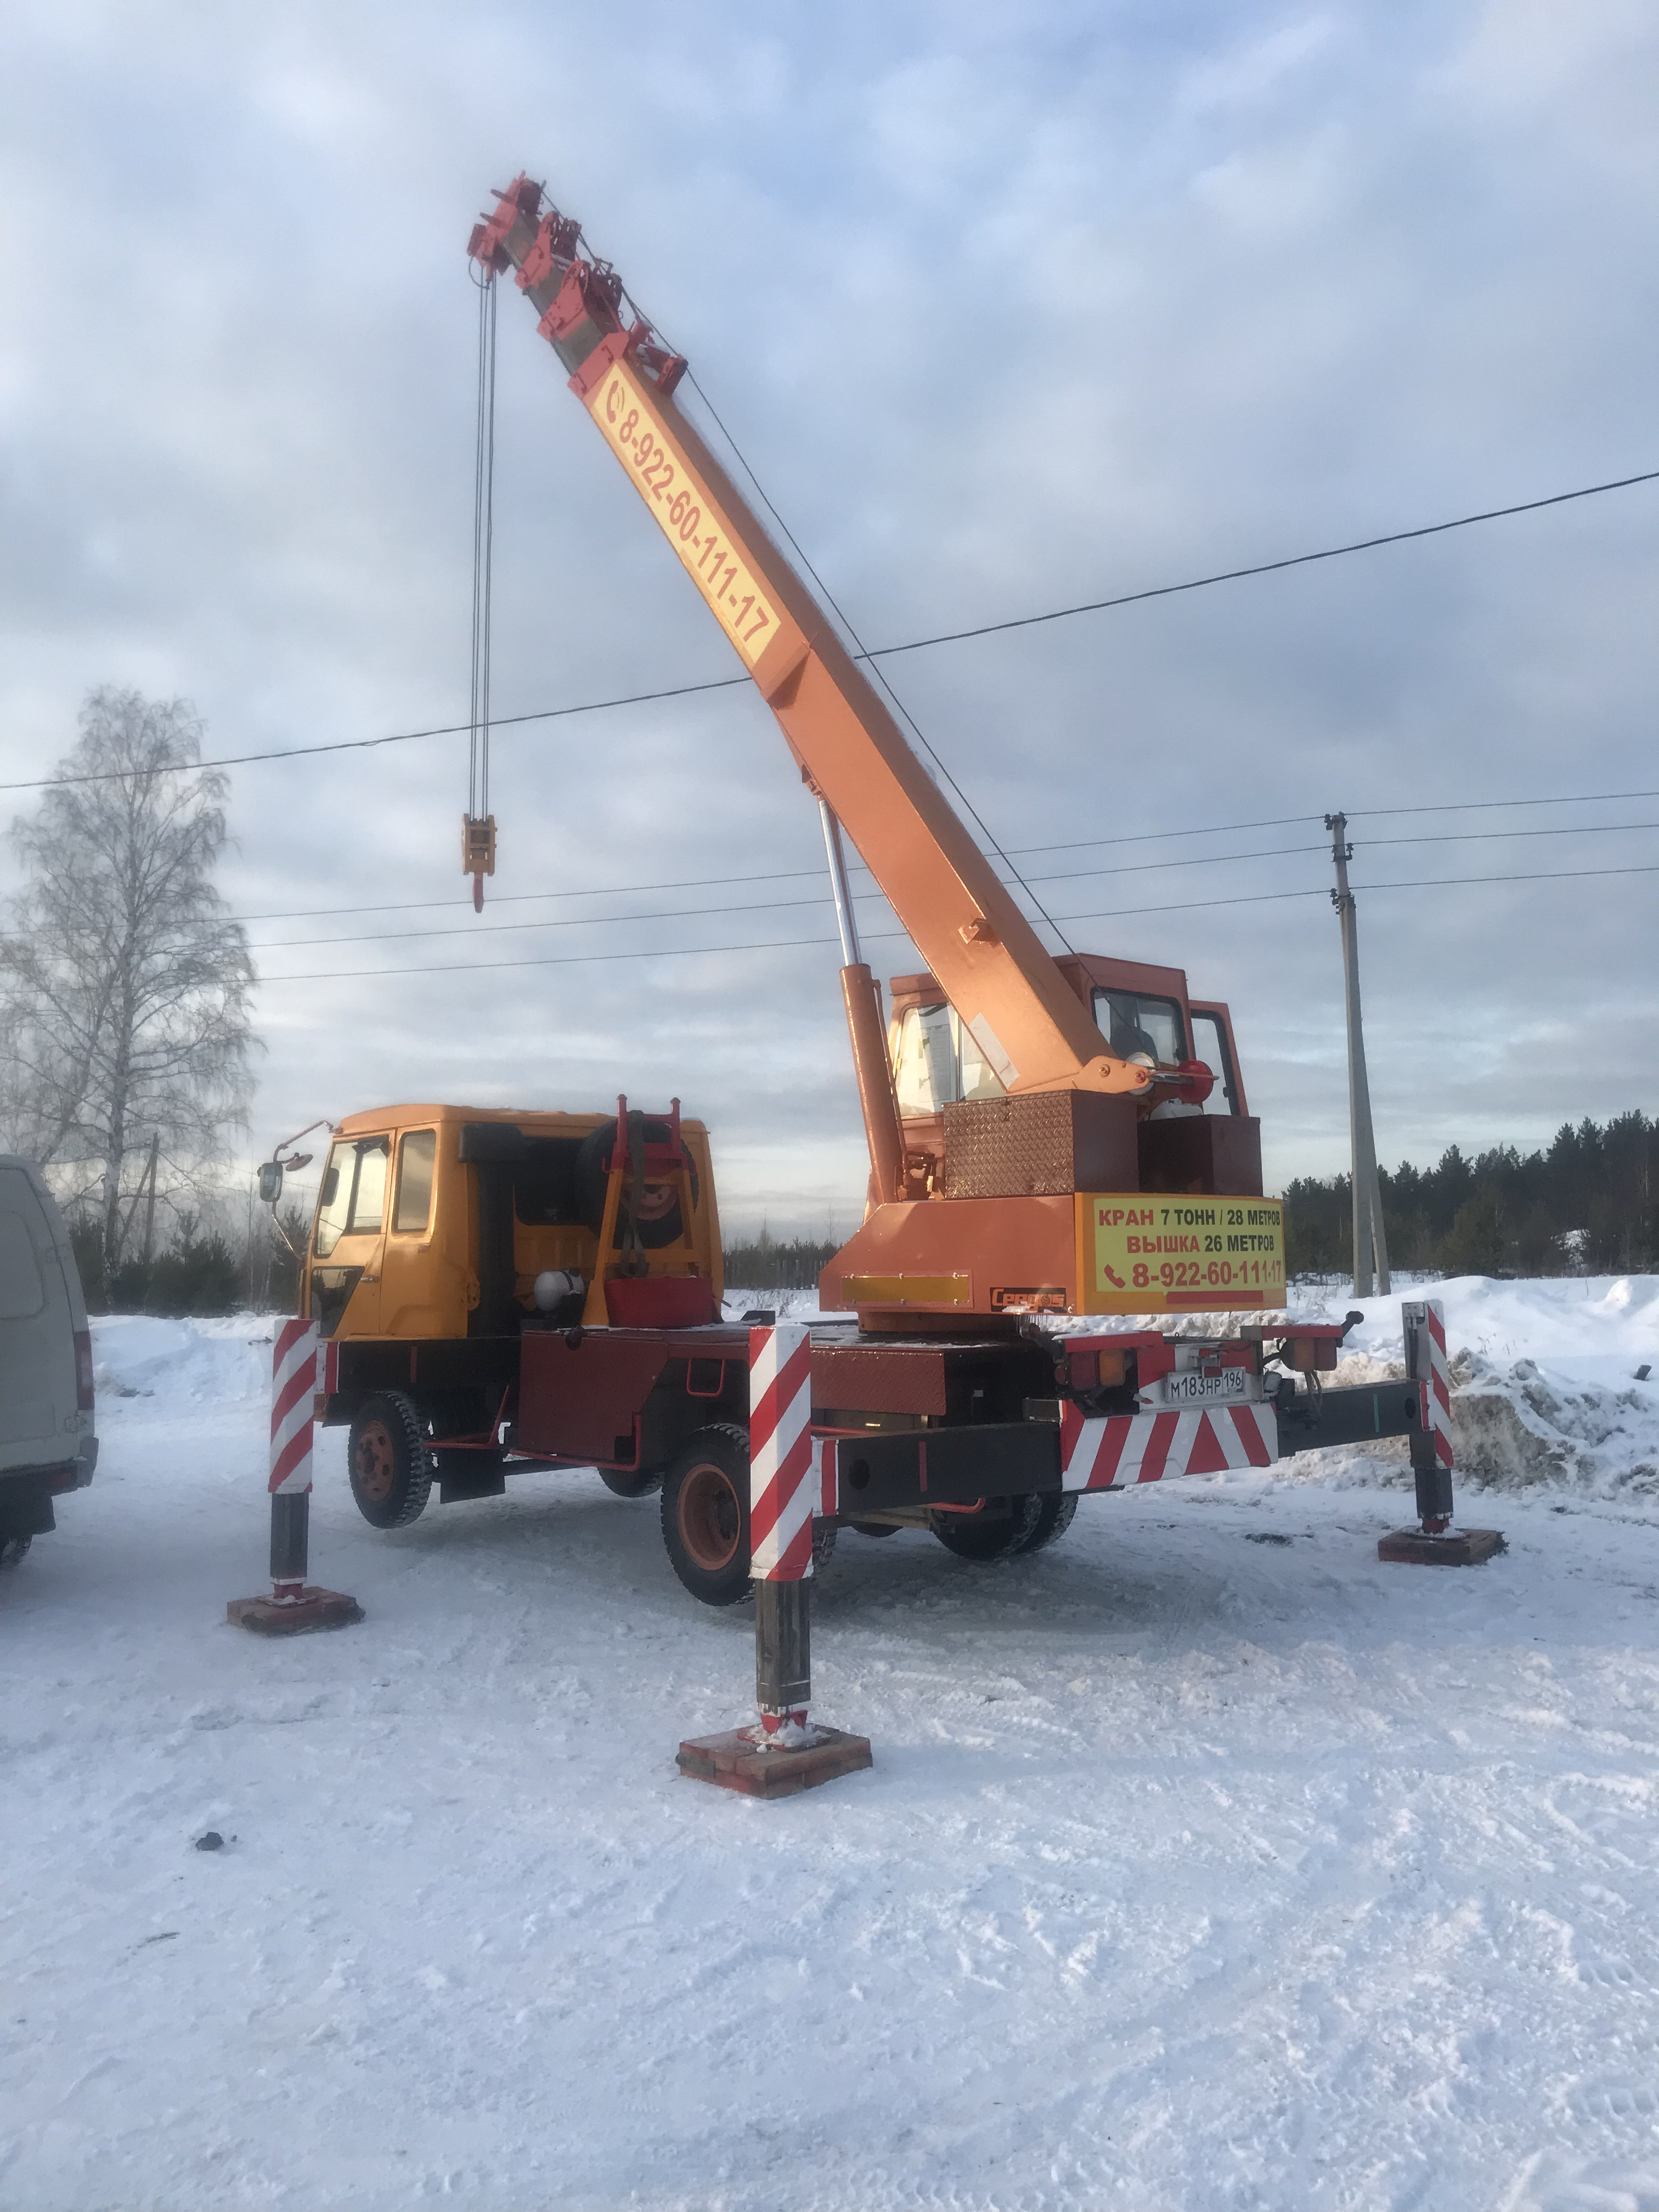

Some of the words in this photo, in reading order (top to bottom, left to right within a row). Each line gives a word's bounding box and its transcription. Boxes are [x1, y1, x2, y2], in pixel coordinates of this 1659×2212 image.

[619, 409, 770, 642] 8-922-60-111-17
[1099, 1209, 1154, 1226] КРАН
[1160, 1209, 1170, 1226] 7
[1174, 1209, 1215, 1226] ТОНН
[1227, 1209, 1244, 1226] 28
[1248, 1210, 1280, 1226] МЕТРОВ
[1126, 1235, 1200, 1254] ВЫШКА
[1204, 1234, 1223, 1252] 26
[1227, 1234, 1274, 1252] МЕТРОВ
[1132, 1260, 1282, 1288] 8-922-60-111-17
[1223, 1372, 1242, 1387] 196
